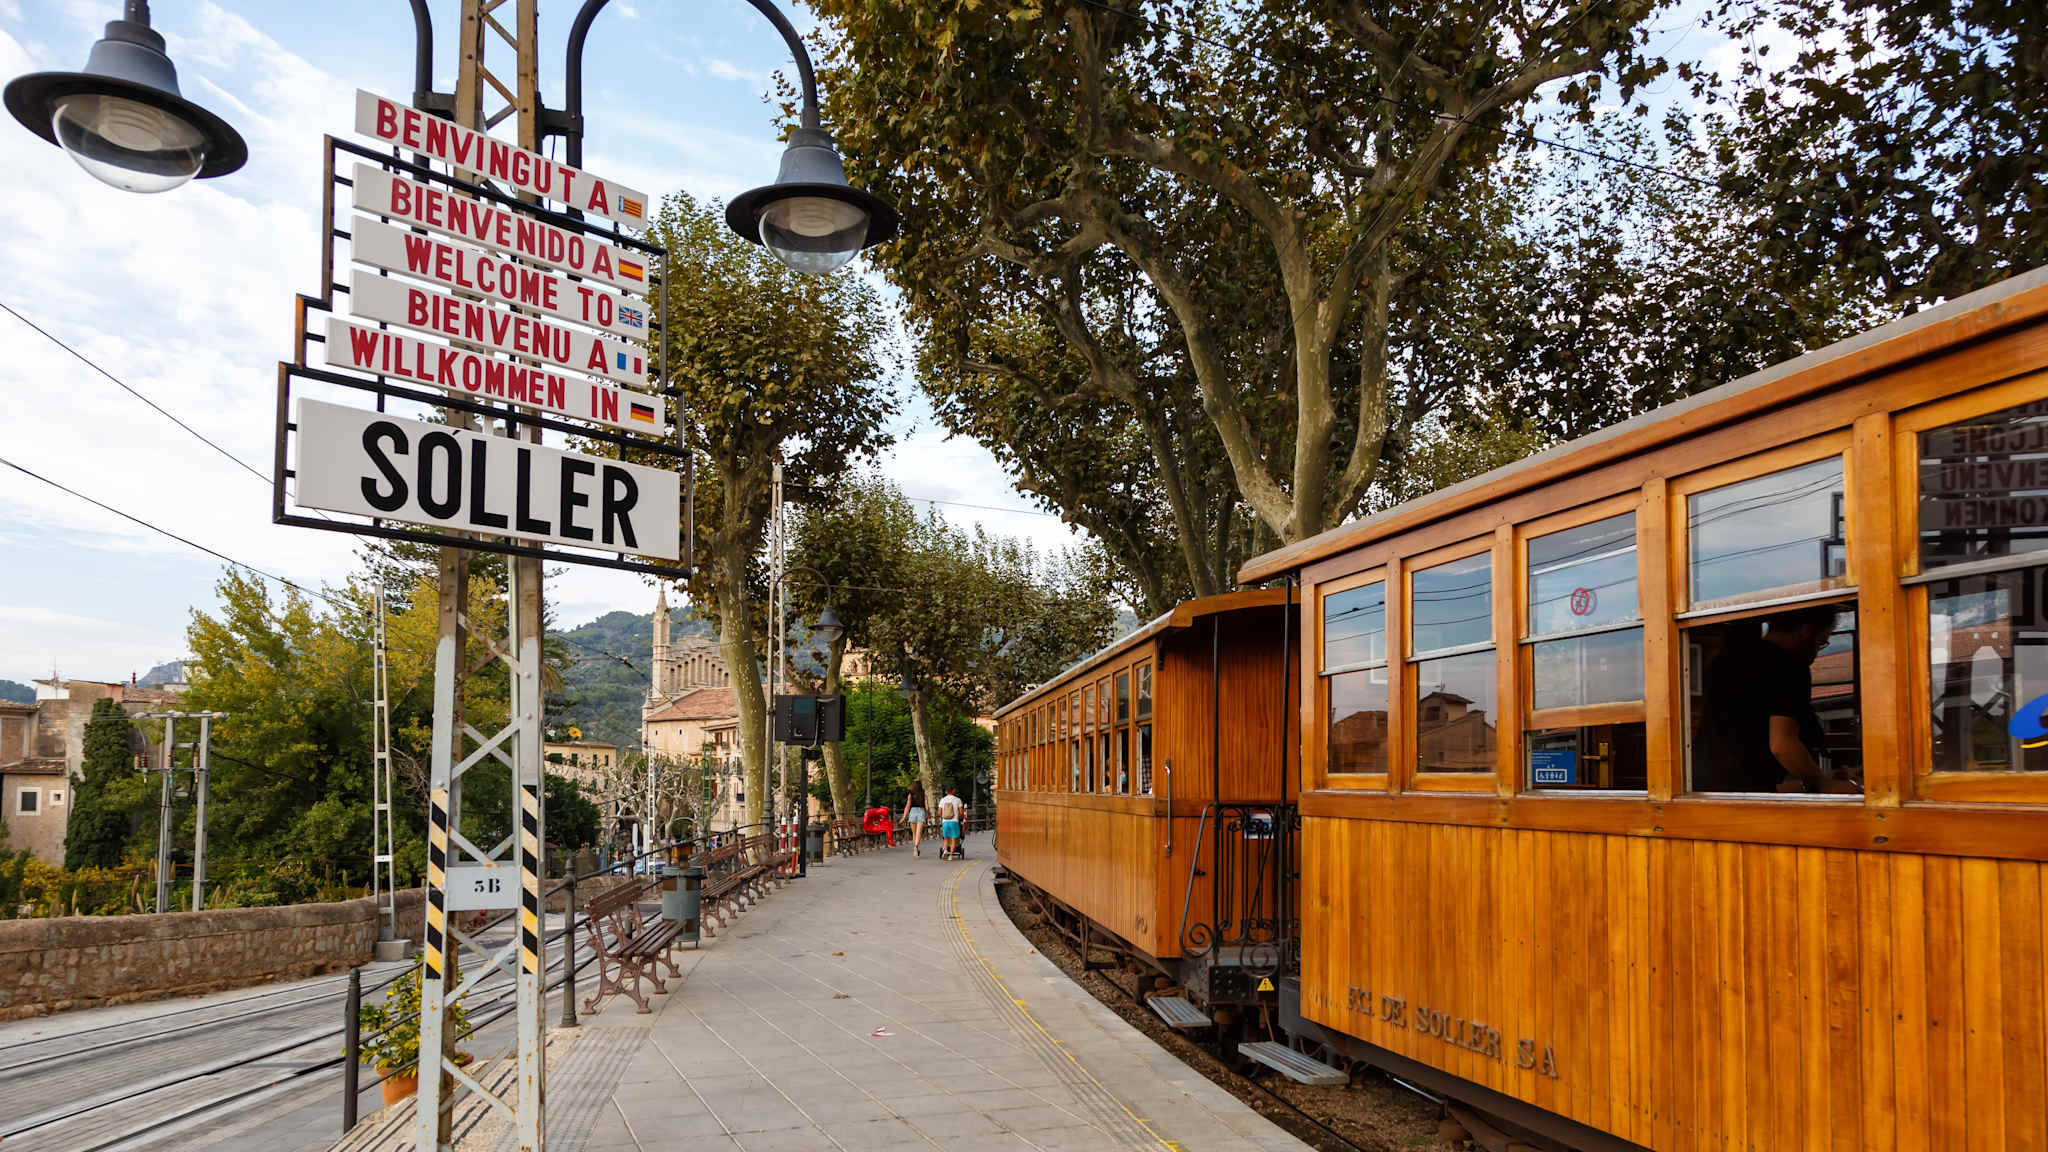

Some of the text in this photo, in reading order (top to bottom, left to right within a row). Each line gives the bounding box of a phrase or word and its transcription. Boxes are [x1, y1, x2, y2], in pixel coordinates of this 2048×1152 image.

[376, 99, 609, 216] BENVINGUT A
[391, 178, 614, 281] BIENVENIDO A
[405, 233, 613, 327] WELCOME TO
[350, 327, 619, 423] WILLKOMMEN IN
[408, 288, 609, 374] BIENVENU A
[360, 420, 639, 549] SÓLLER
[1380, 994, 1407, 1027] DE
